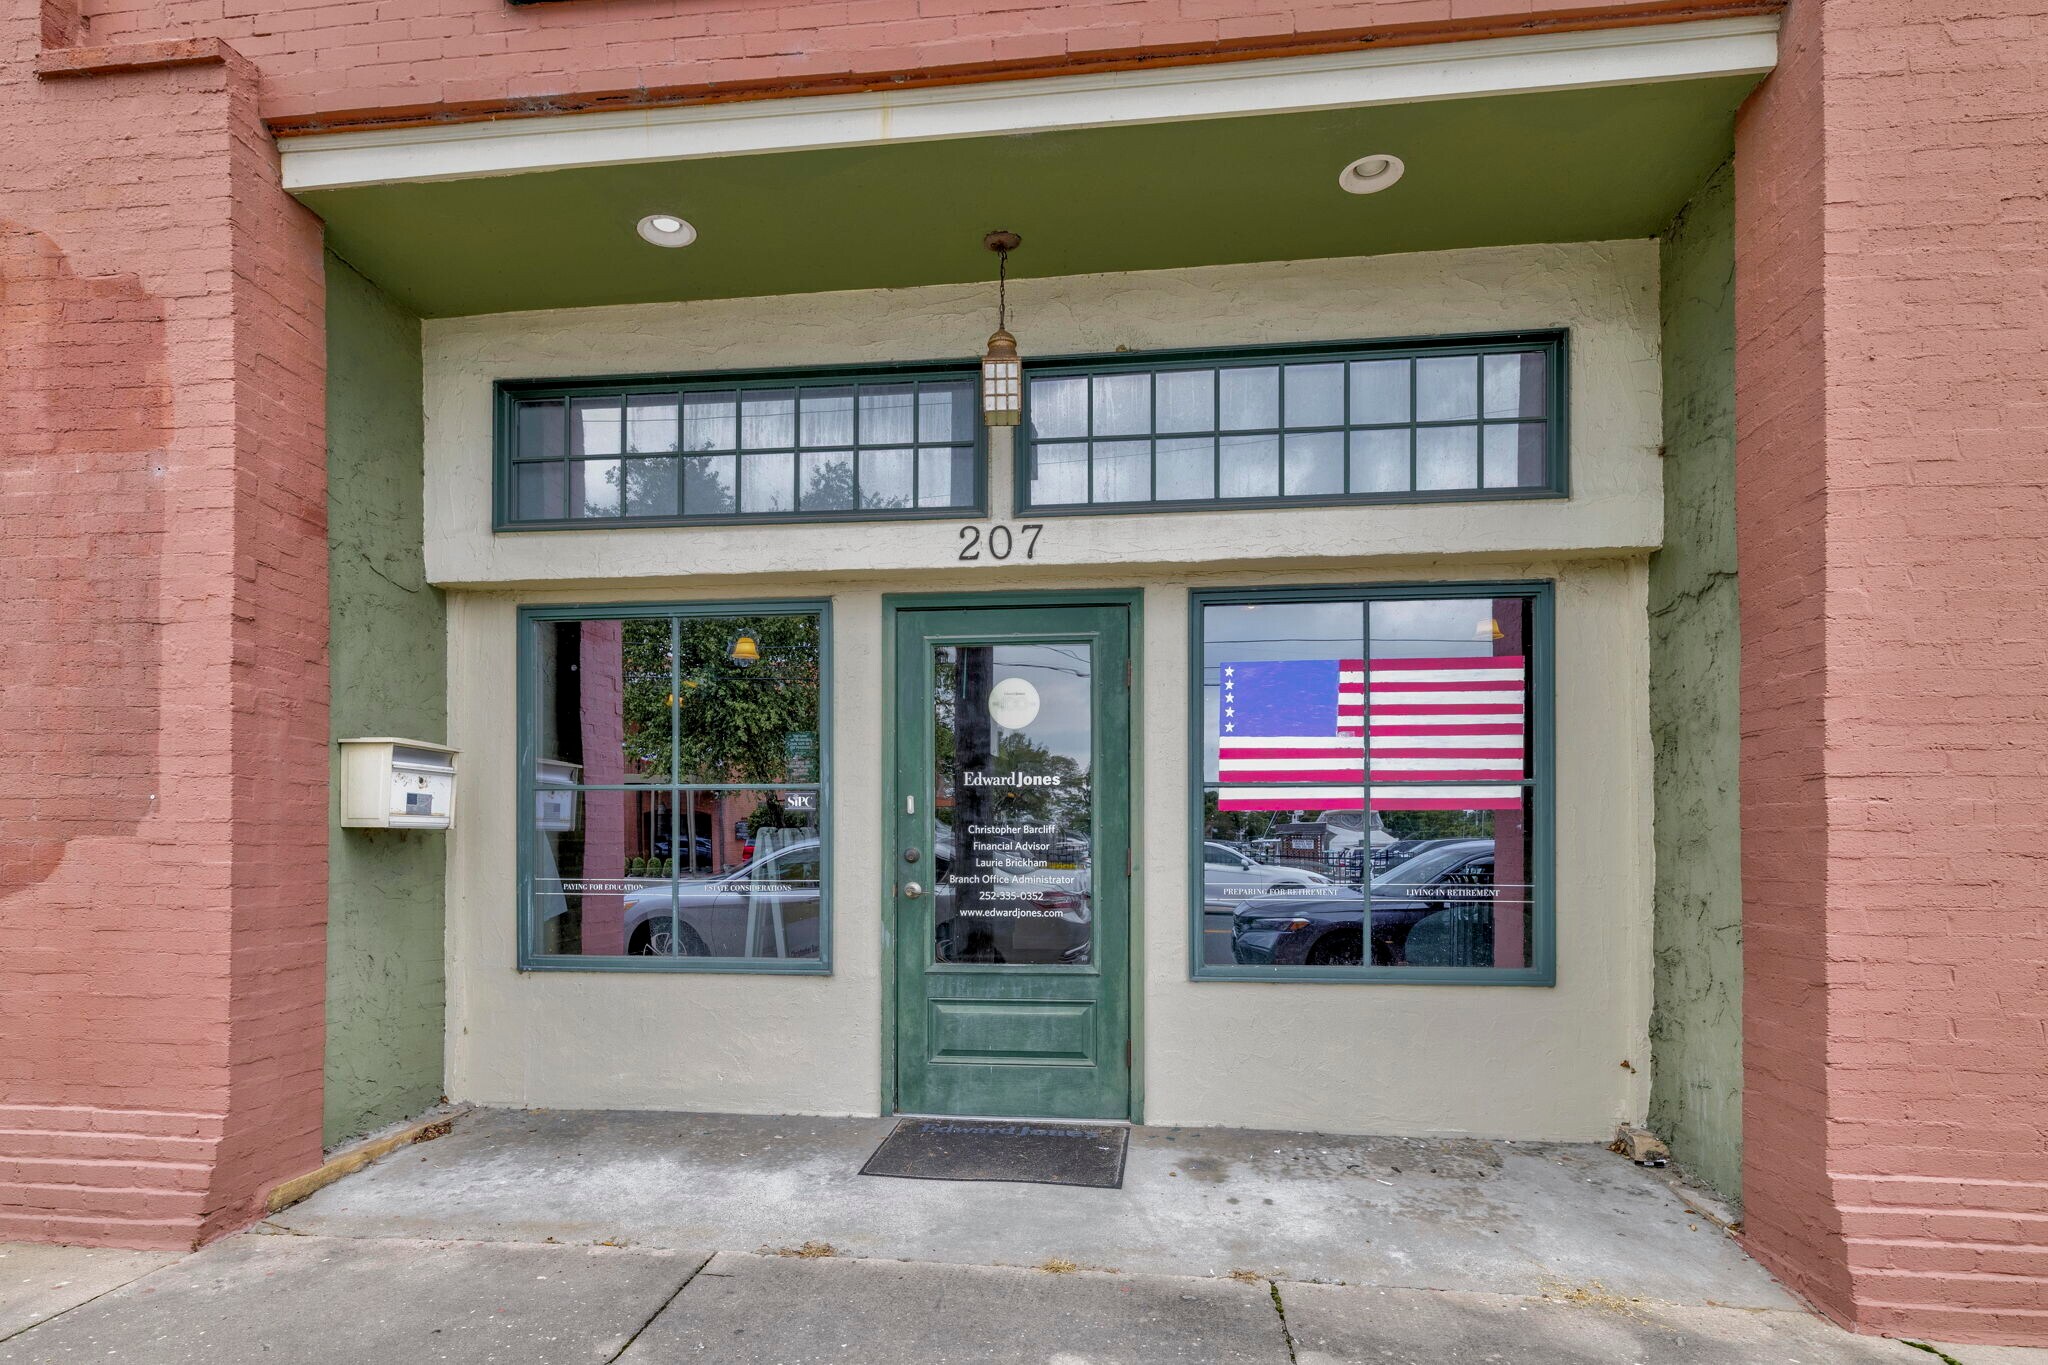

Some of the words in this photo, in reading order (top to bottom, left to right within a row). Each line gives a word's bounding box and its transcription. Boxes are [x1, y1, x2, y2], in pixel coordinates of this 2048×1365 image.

[959, 524, 1043, 560] 207
[968, 824, 1021, 835] Christopher
[1023, 824, 1056, 834] Barcliff
[973, 841, 1013, 851] Financial
[1015, 842, 1050, 851] Advisor
[976, 858, 1003, 867] Laurie
[1006, 858, 1048, 868] Brickham
[949, 874, 980, 884] Branch
[982, 874, 1009, 884] Office
[1011, 875, 1075, 885] Administrator
[563, 883, 588, 891] PAYING
[589, 883, 603, 891] FOR
[604, 883, 644, 892] EDUCATION
[704, 884, 729, 892] ESTATE
[730, 884, 792, 893] CONSIDERATIONS
[1223, 888, 1268, 896] PREPARING
[1269, 888, 1286, 896] FOR
[1287, 888, 1338, 897] RETIREMENT
[1406, 888, 1434, 896] LIVING
[1436, 888, 1446, 896] IN
[1447, 888, 1500, 897] RETIREMENT
[979, 891, 1044, 901] 252-335-0352
[959, 907, 1064, 919] www.edwardjones.com
